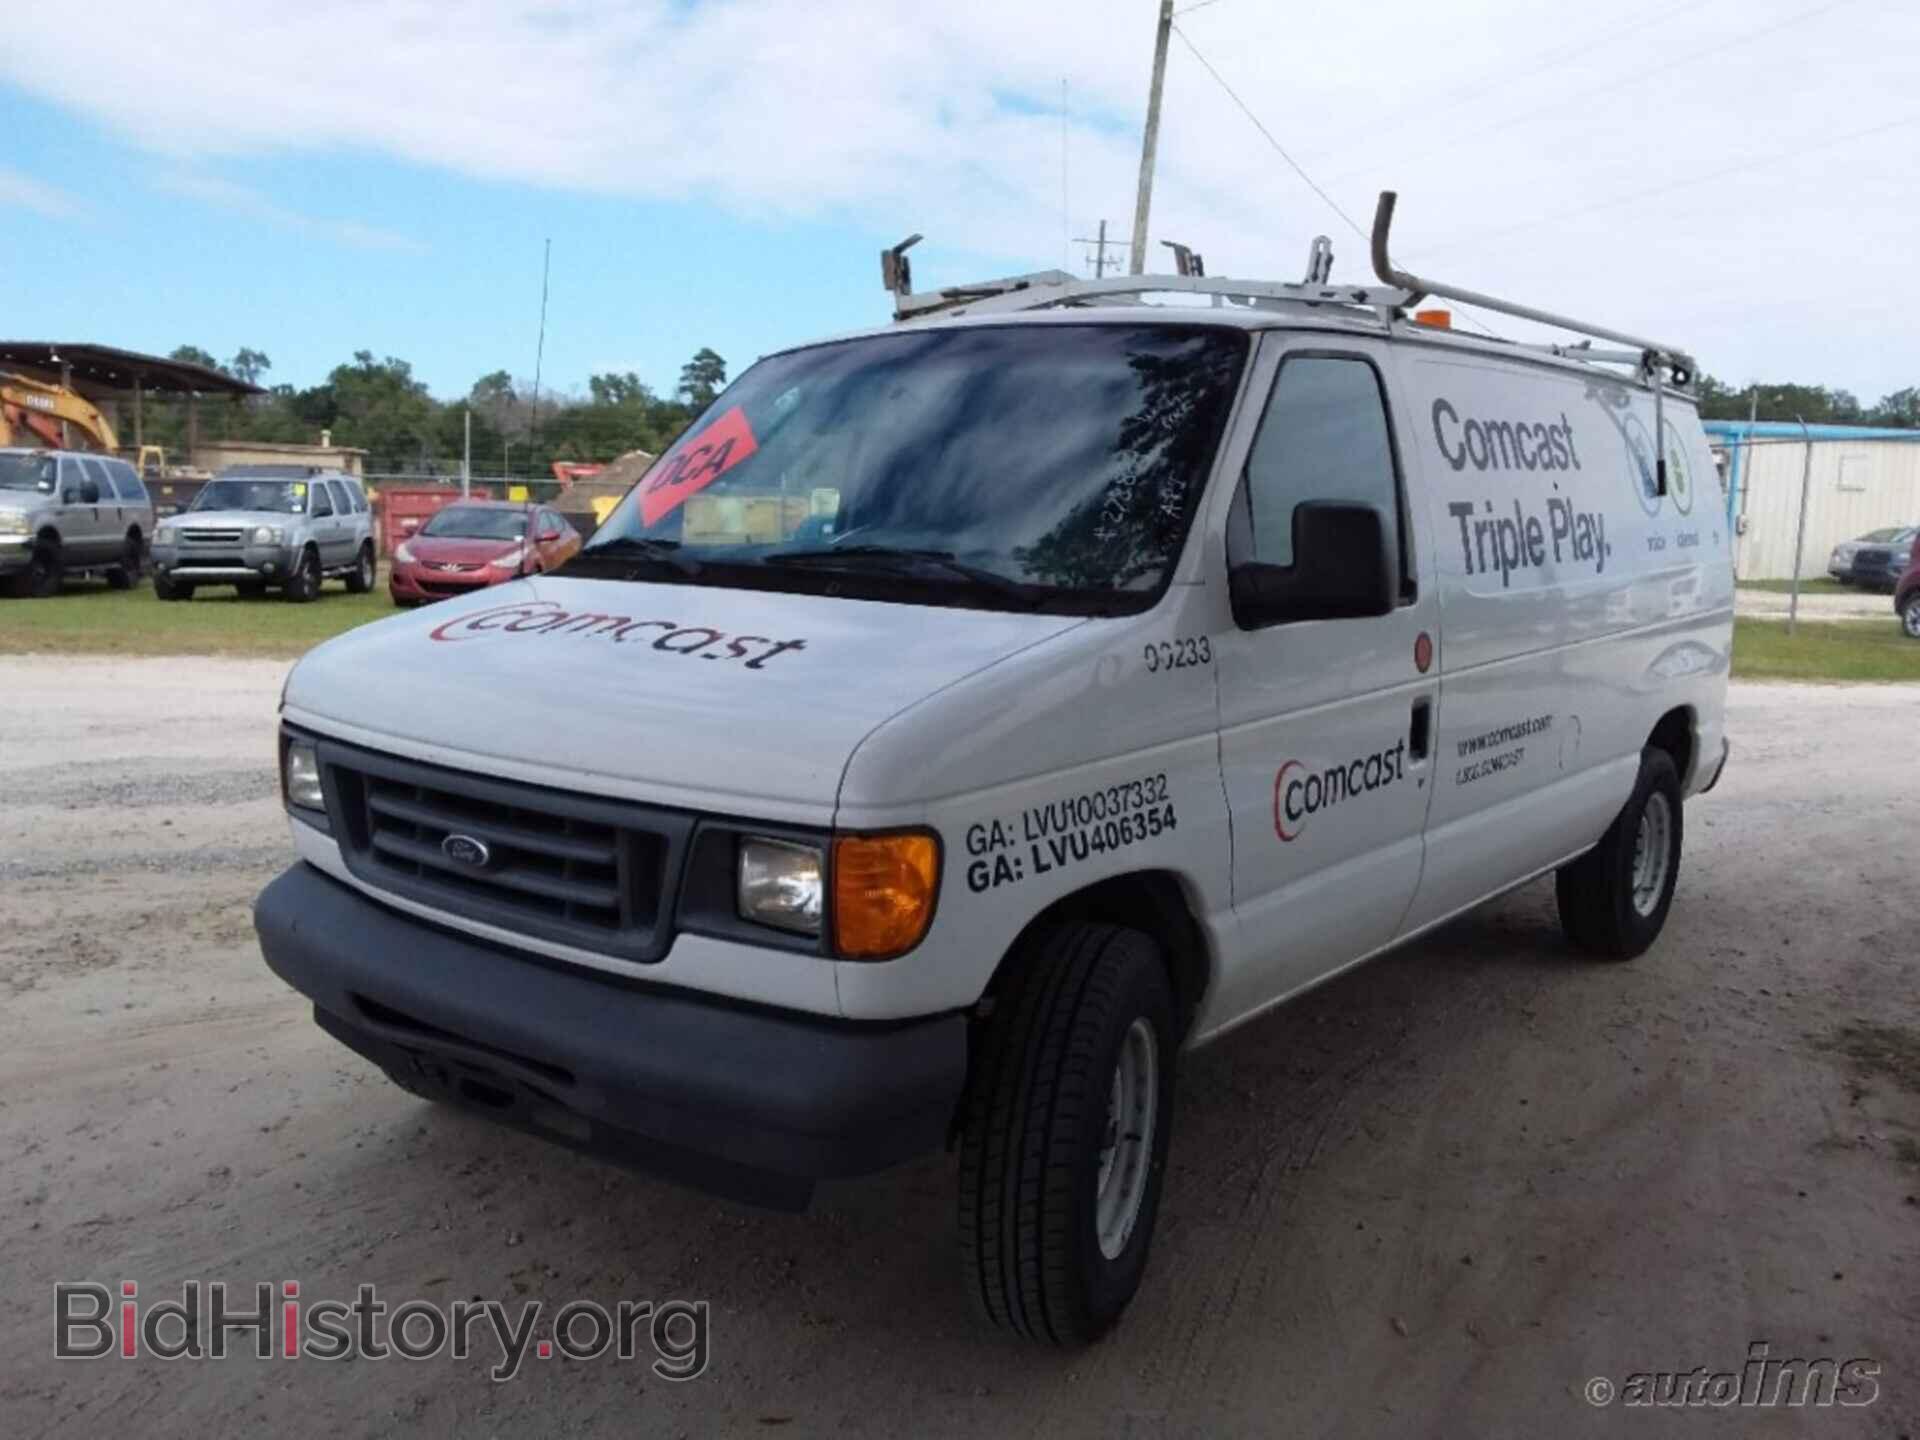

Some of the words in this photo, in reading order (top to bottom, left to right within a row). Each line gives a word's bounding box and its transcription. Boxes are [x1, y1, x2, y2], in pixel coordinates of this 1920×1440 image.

[1431, 397, 1582, 472] Comcast
[1448, 500, 1546, 588] Triple
[1547, 496, 1612, 574] Play.
[965, 818, 1017, 856] GA:
[1023, 773, 1170, 842] LVU10037332
[966, 852, 1025, 894] GA:
[1031, 802, 1178, 875] LVU406354
